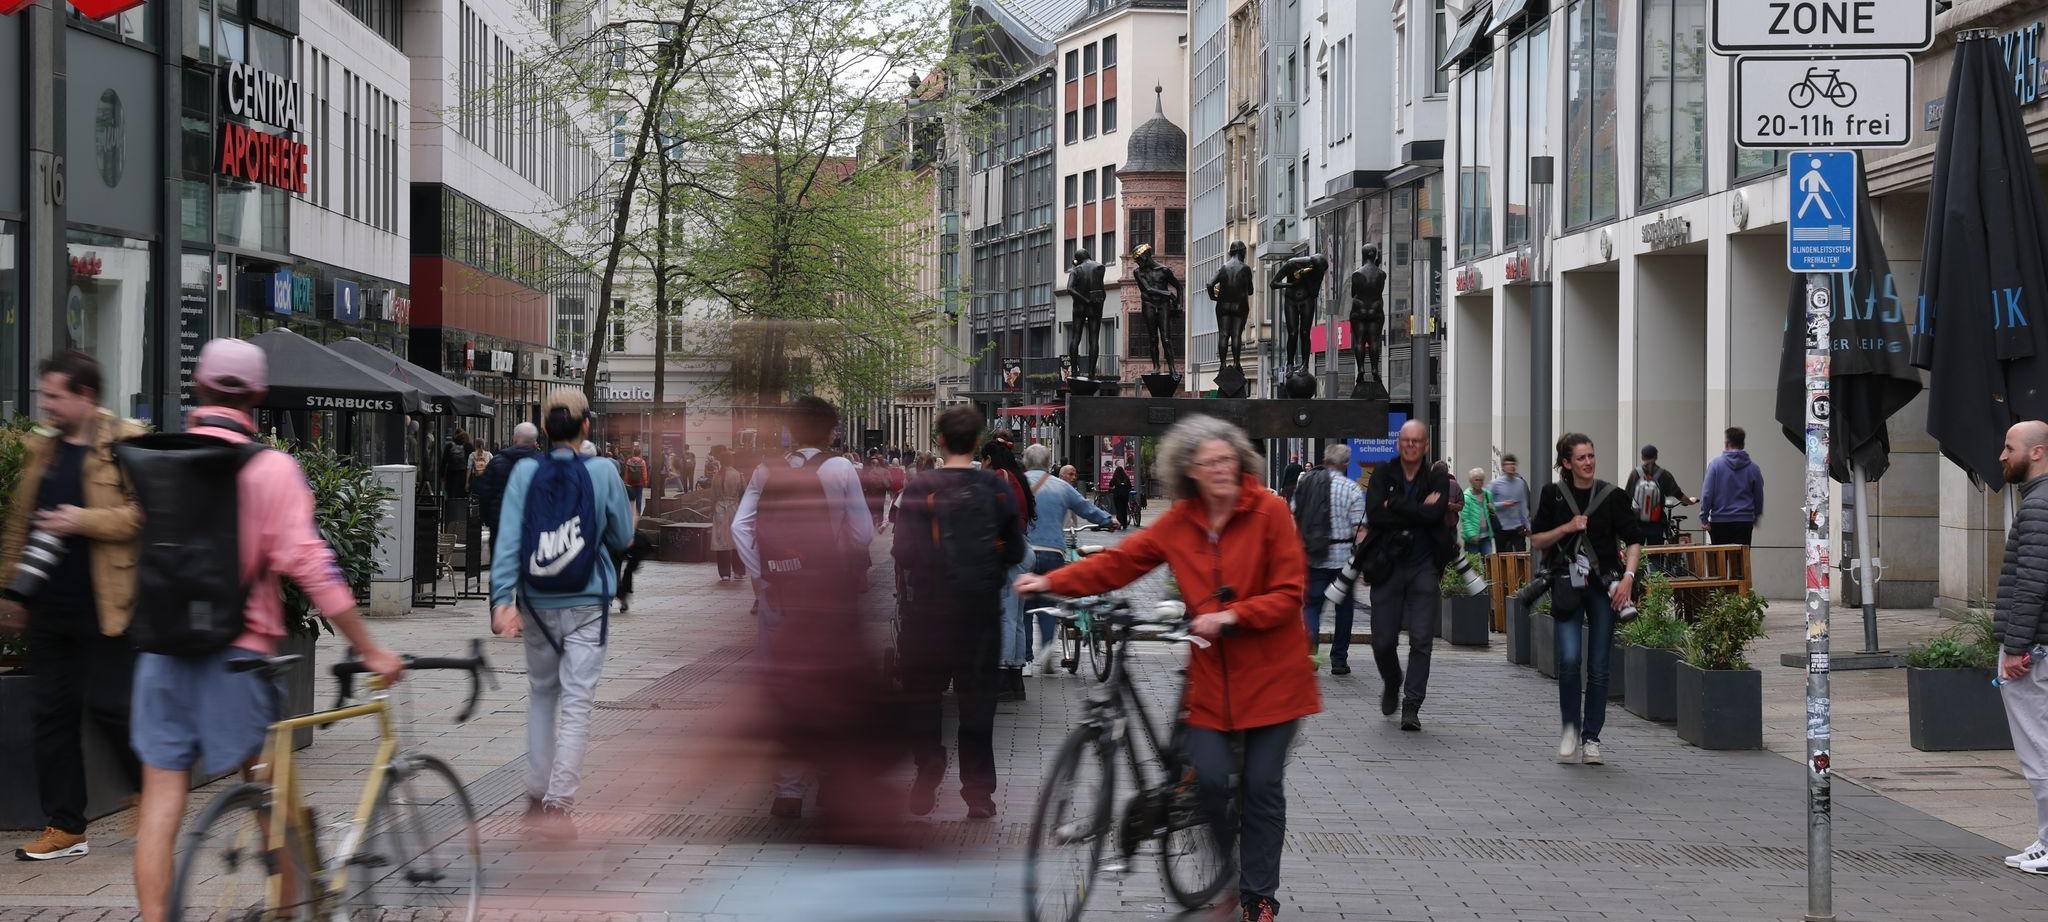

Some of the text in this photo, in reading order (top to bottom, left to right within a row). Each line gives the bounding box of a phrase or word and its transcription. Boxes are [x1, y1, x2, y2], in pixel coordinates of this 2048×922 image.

[1768, 2, 1875, 35] ZONE
[227, 60, 303, 131] CENTRAL
[1757, 113, 1890, 136] 20-11h frei
[221, 123, 308, 193] APOTHEKE
[41, 156, 65, 206] 16
[1792, 246, 1851, 254] BLINDENLEITSYSTEM
[1803, 256, 1840, 264] FREIHALTEN!
[306, 396, 394, 411] STARBUCKS
[1359, 445, 1394, 453] schneller.
[537, 515, 583, 557] NIKE
